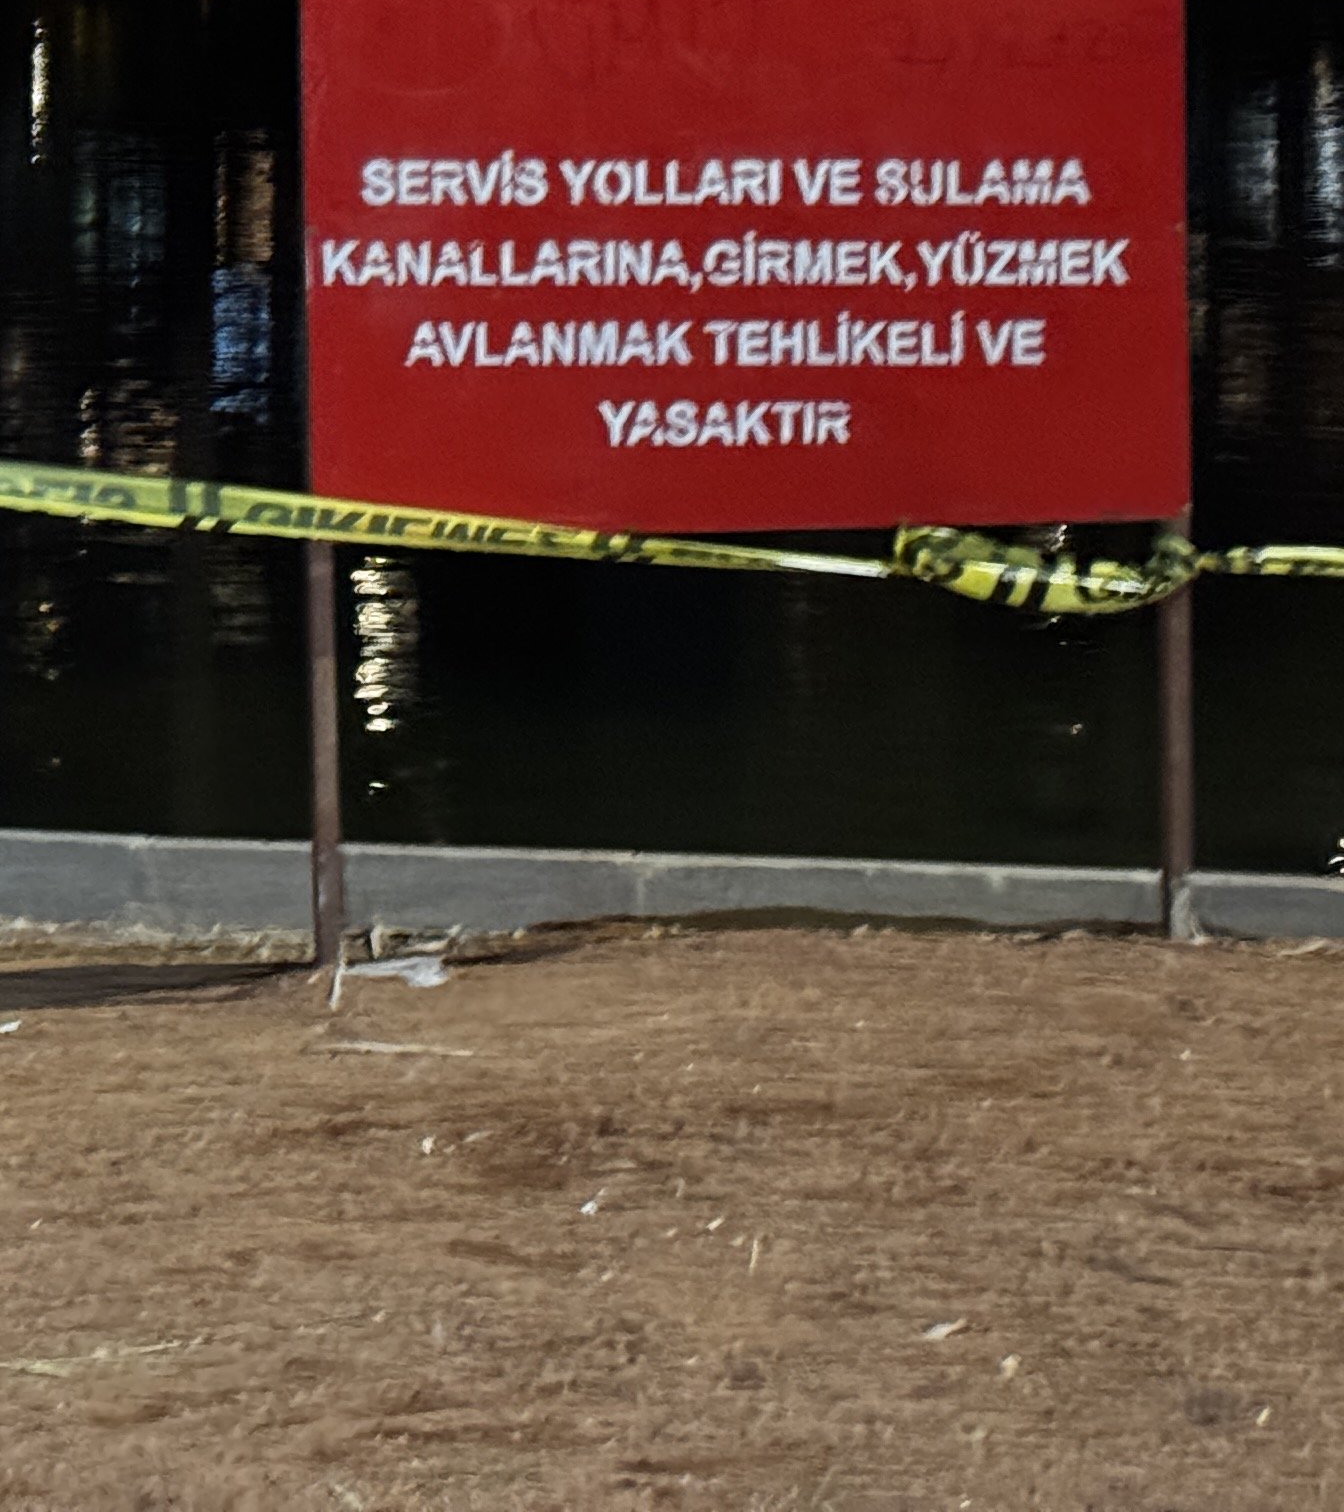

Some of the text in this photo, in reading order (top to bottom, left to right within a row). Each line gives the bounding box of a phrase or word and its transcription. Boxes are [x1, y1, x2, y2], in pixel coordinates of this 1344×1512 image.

[359, 148, 1092, 207] SERVİS YOLLARI VE SULAMA
[404, 309, 1046, 368] AVLANMAK TEHLİKELİ VE
[597, 398, 852, 448] YASAKTIR
